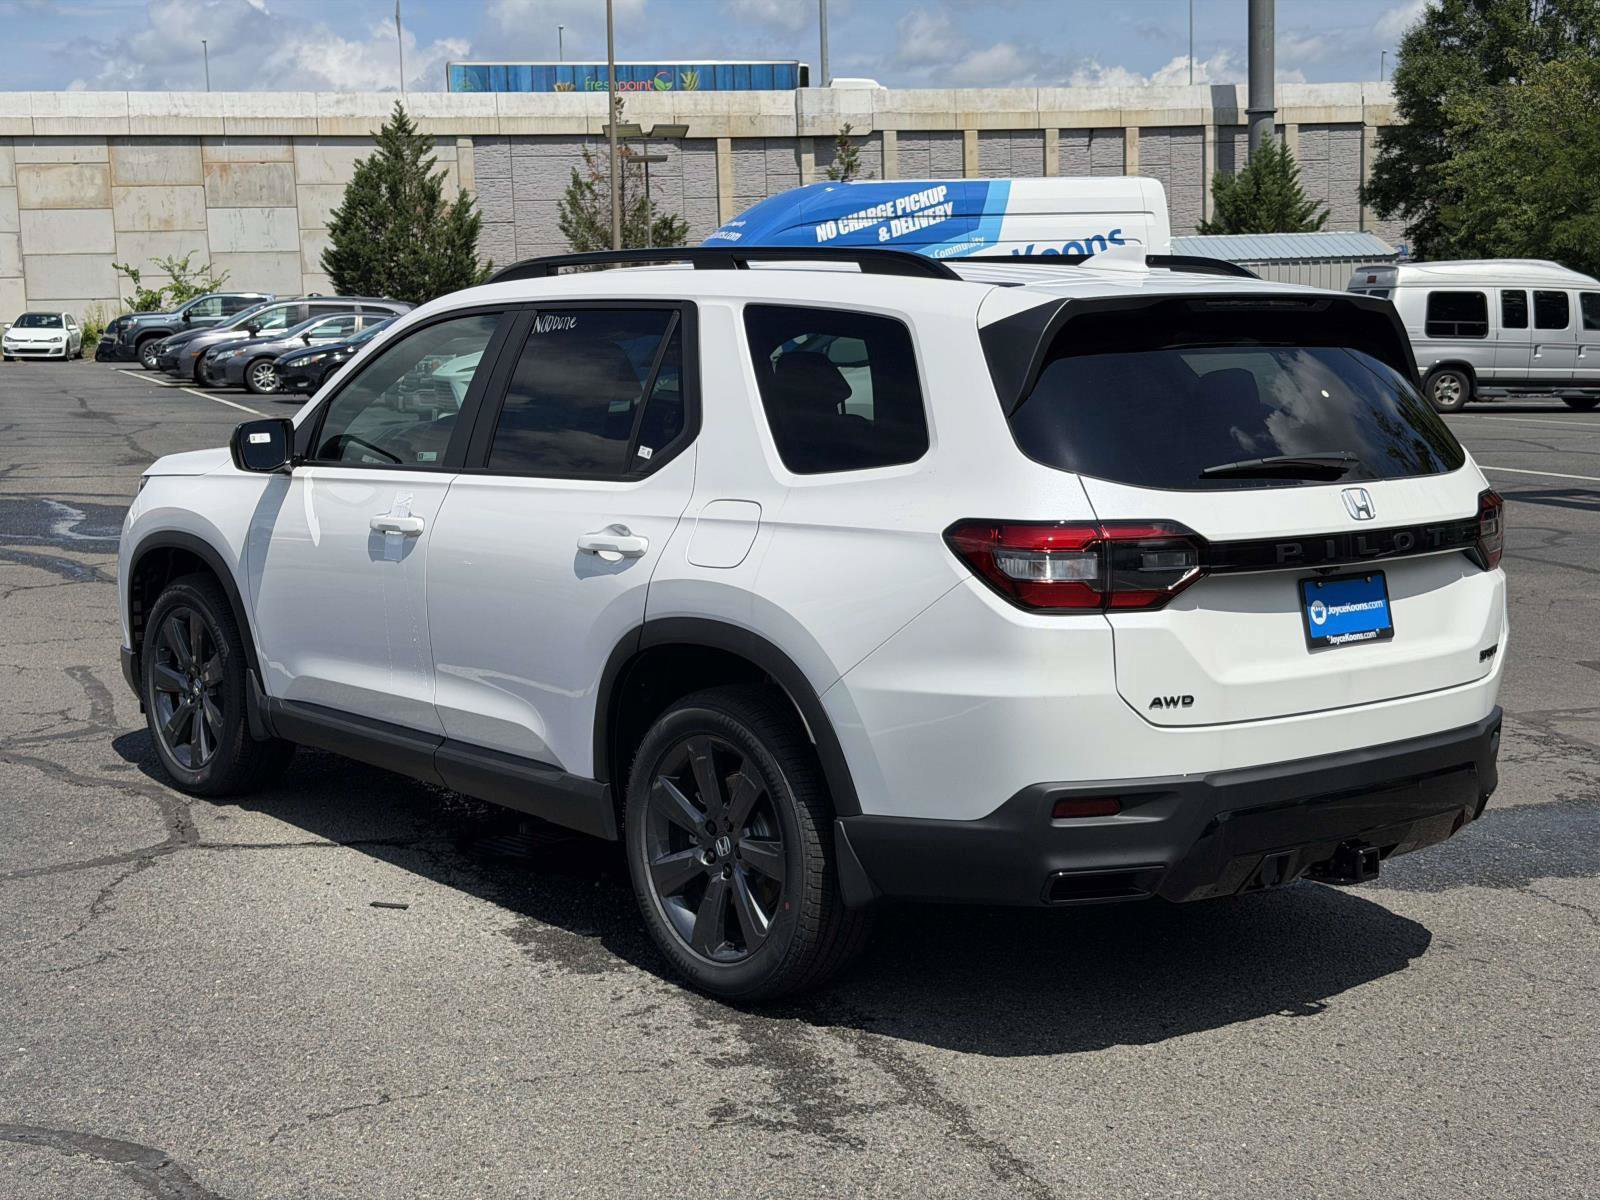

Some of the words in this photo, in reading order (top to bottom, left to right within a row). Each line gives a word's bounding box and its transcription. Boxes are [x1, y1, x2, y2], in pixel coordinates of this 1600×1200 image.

[815, 220, 838, 243] NO
[838, 201, 895, 235] CHARGE
[895, 184, 948, 216] PICKUP
[878, 226, 891, 242] &
[889, 202, 954, 238] DELIVERY
[934, 236, 985, 258] Community
[1275, 527, 1446, 564] PILOT
[1328, 600, 1384, 616] JoyceKoons.com
[1330, 631, 1377, 646] JoyceKoons.com
[1148, 694, 1195, 710] AWD
